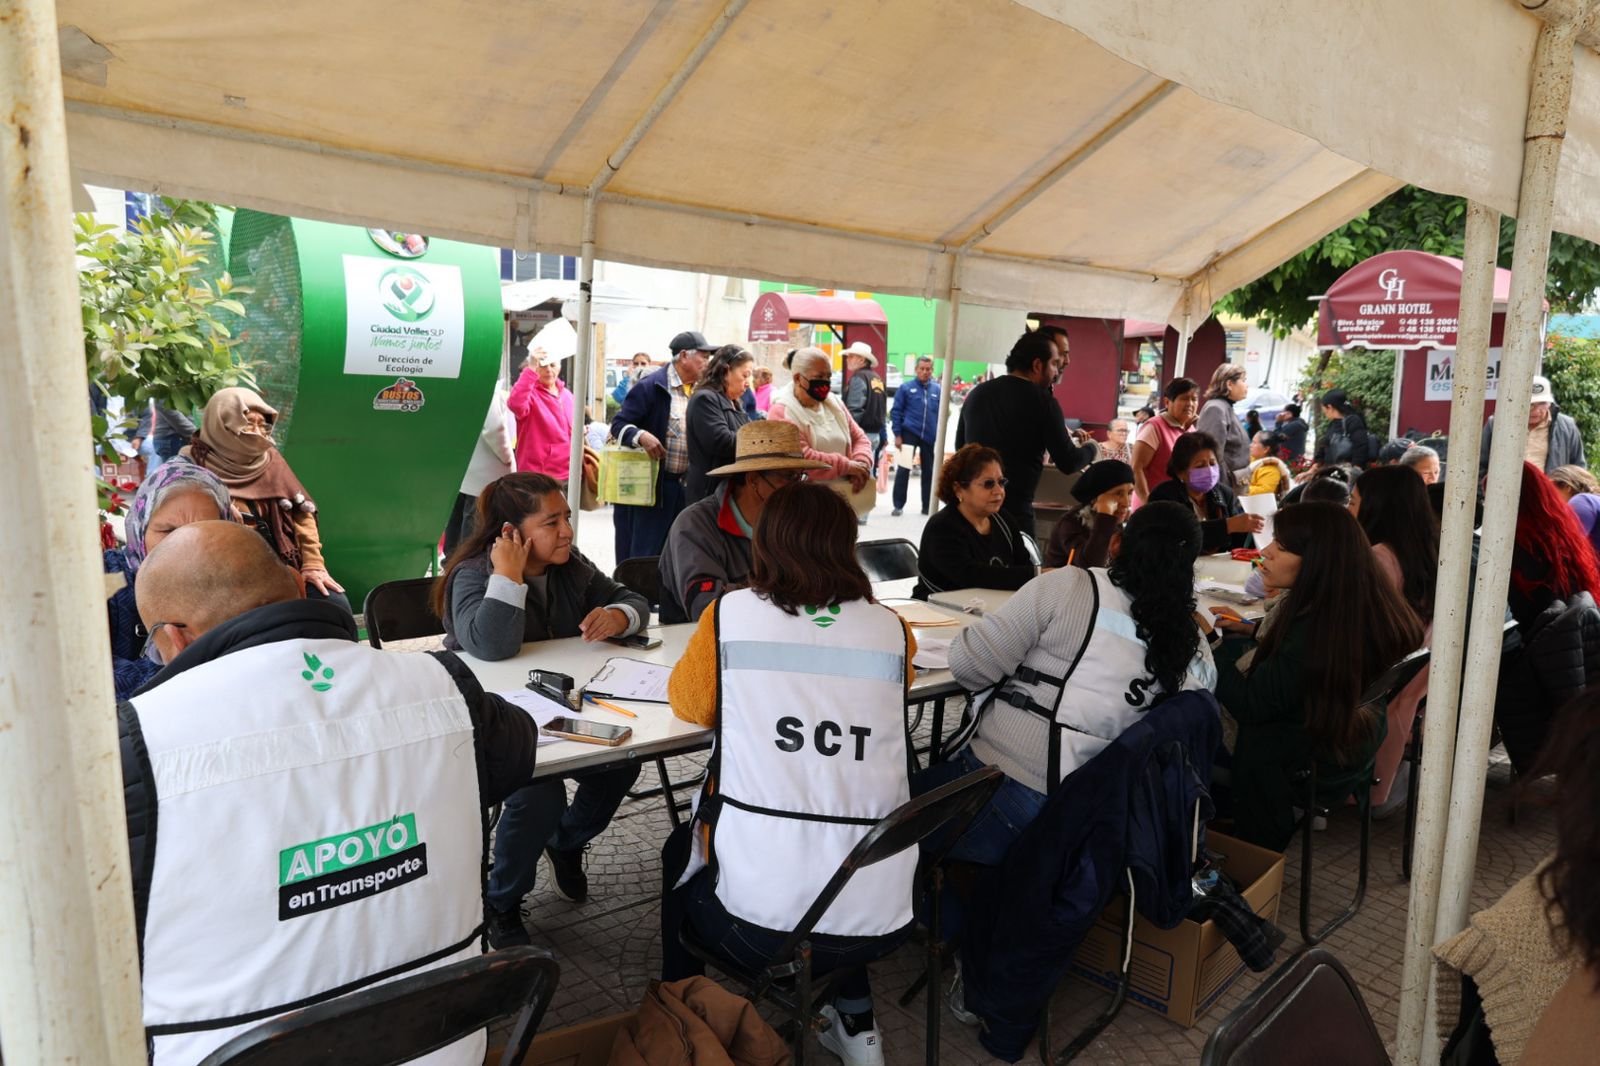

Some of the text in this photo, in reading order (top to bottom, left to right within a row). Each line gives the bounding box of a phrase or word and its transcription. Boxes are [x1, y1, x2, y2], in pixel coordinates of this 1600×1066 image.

[1359, 303, 1432, 315] GRANN HOTEL
[370, 324, 401, 334] Ciudad
[403, 327, 429, 336] Valles
[430, 328, 444, 337] SLP
[378, 354, 433, 365] Dirección de
[382, 390, 420, 400] BUSTOS
[774, 715, 872, 762] SCT
[285, 821, 408, 883] APOYO
[288, 857, 421, 910] en Transporte
